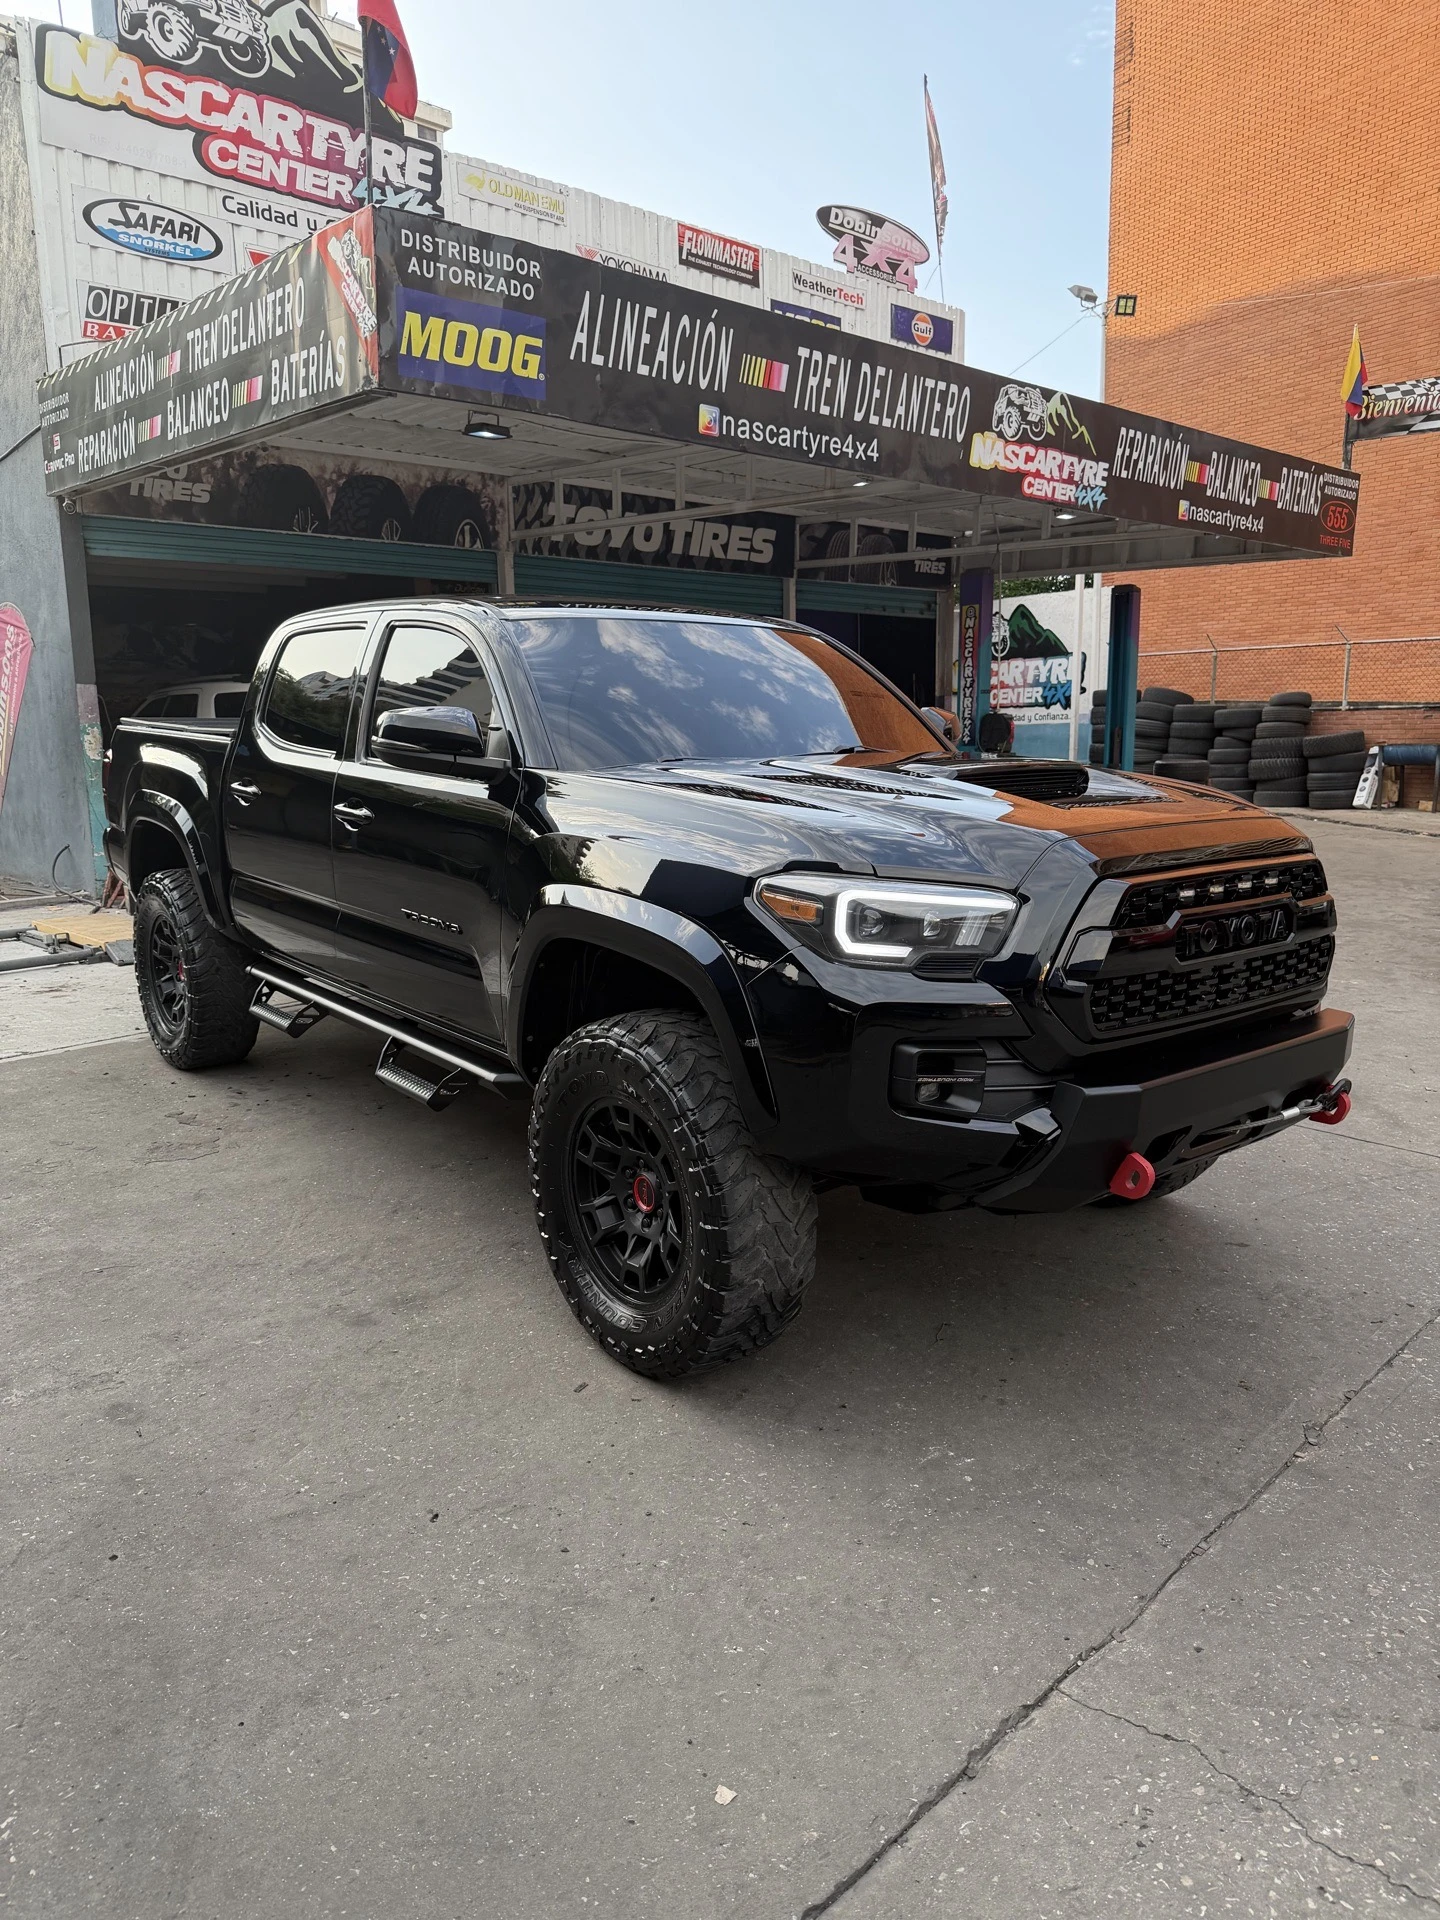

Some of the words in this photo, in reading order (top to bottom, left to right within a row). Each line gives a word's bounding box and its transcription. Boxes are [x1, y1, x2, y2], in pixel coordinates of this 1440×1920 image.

[208, 139, 354, 205] CENTER
[489, 178, 513, 198] OLD
[514, 186, 539, 207] MAN
[541, 196, 565, 215] EMU
[523, 204, 550, 218] SUSPENSION
[108, 201, 201, 244] SAFARI
[222, 195, 298, 228] Calidad
[307, 217, 317, 235] y
[829, 207, 922, 254] Dobinsons
[118, 233, 194, 257] SNORKEL
[144, 247, 170, 257] SYSTEMS
[401, 228, 541, 280] DISTRIBUIDOR
[682, 230, 755, 272] FLOWMASTER
[408, 257, 535, 300] AUTORIZADO
[793, 273, 864, 306] WeatherTech
[857, 264, 896, 284] ACCESSORIES
[913, 321, 932, 336] Gulf
[94, 345, 155, 413] ALINEACIÓN
[187, 318, 218, 374] TREN
[221, 277, 305, 360] DELANTERO
[400, 311, 543, 380] MOOG
[570, 290, 734, 393] ALINEACIÓN
[793, 346, 852, 418] TREN
[853, 362, 971, 443] DELANTERO
[39, 392, 70, 414] DISTRIBUIDOR
[41, 407, 70, 428] AUTORIZADO
[78, 410, 135, 474] REPARACIÓN
[167, 377, 229, 441] BALANCEO
[271, 330, 345, 406] BATERÍAS
[722, 415, 880, 463] nascartyre4x4
[1112, 426, 1190, 491] REPARACIÓN
[1206, 451, 1261, 507] BALANCEO
[1276, 465, 1324, 517] BATERÍAS
[1324, 472, 1359, 489] DISTRIBUIDOR
[130, 477, 212, 504] TIRES
[1023, 476, 1076, 502] CENTER
[1324, 485, 1357, 501] AUTORIZADO
[1189, 504, 1264, 534] nascartyre4x4
[1327, 505, 1349, 530] 555
[669, 519, 777, 564] TIRES
[1320, 534, 1338, 547] THREE
[1339, 538, 1351, 549] FIVE
[914, 559, 946, 575] TIRES
[990, 686, 1043, 706] CENTER
[1027, 715, 1032, 723] y
[1183, 909, 1287, 956] TOYOTA
